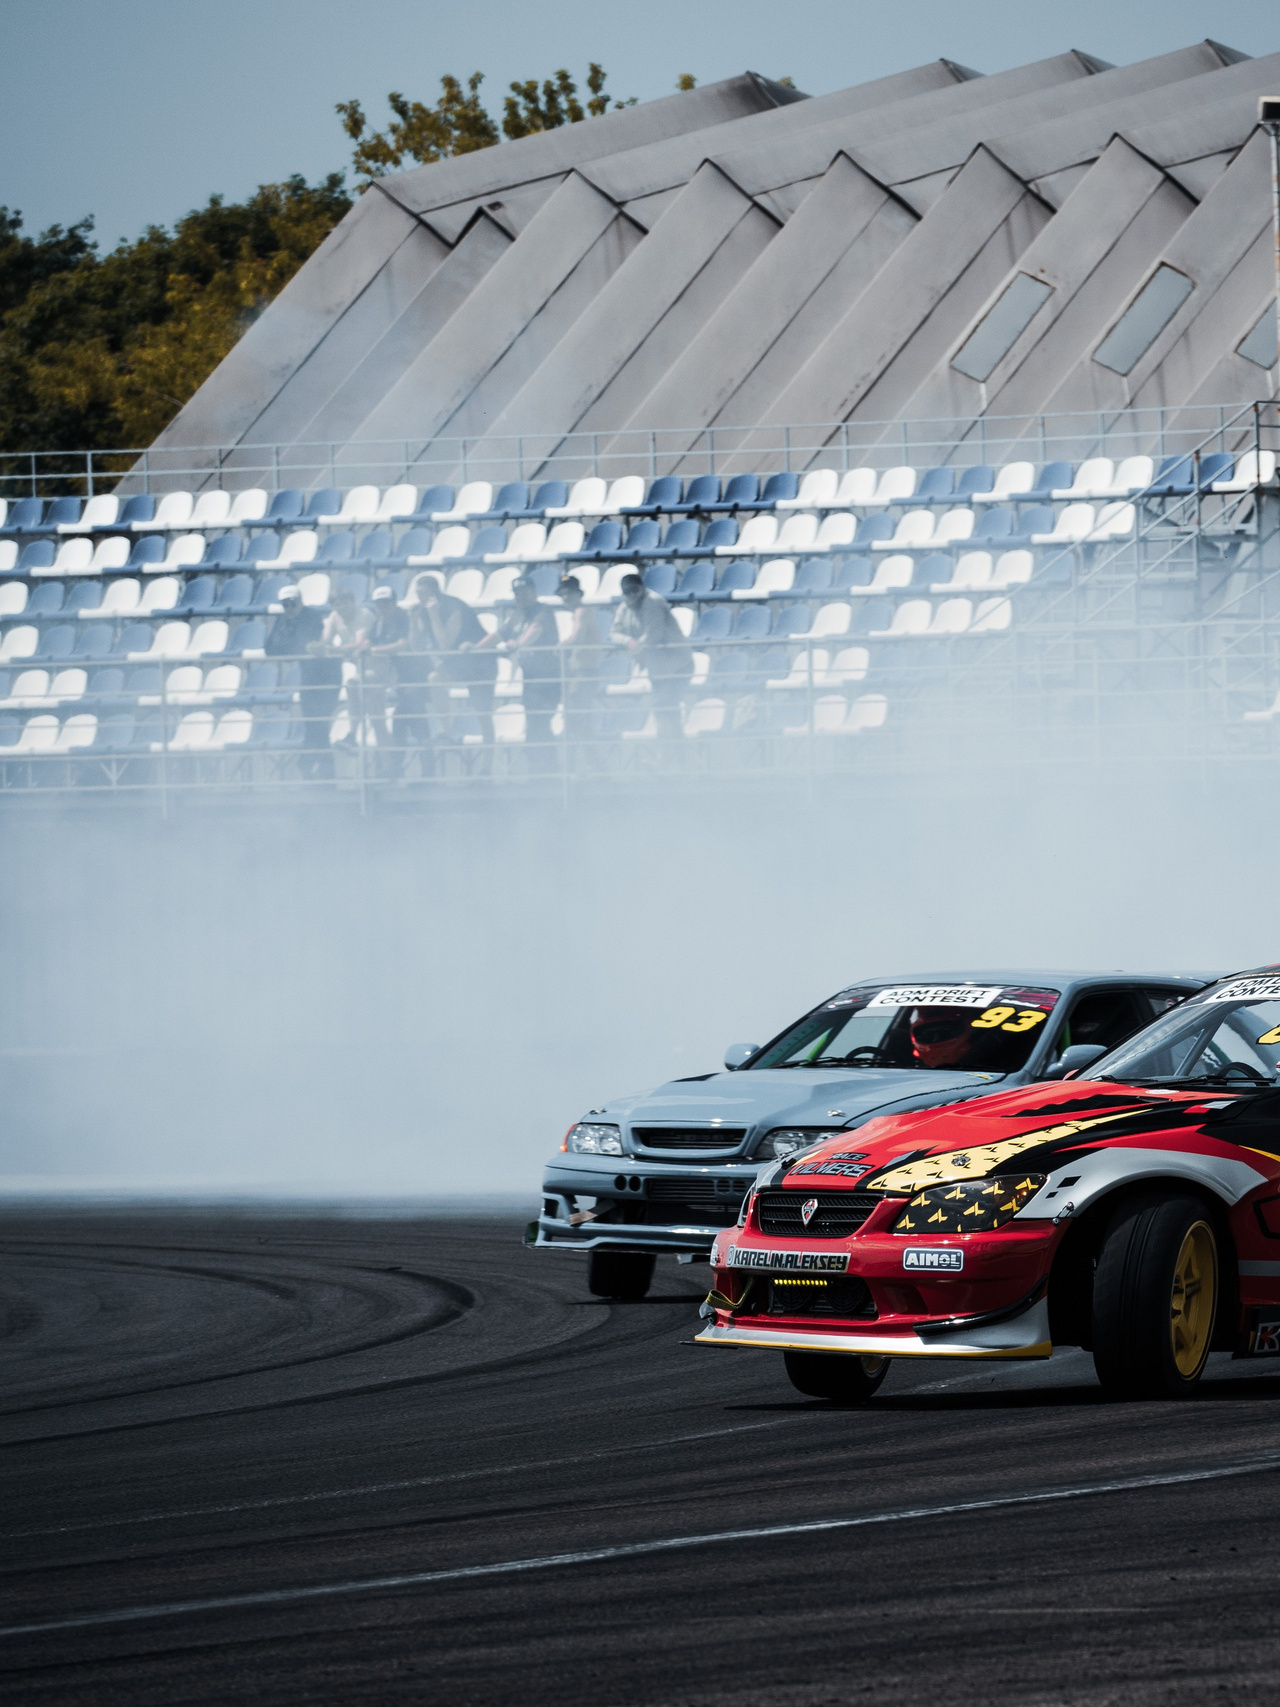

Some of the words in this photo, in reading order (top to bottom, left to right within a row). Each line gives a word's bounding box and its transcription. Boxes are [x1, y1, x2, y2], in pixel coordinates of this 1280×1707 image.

[1230, 977, 1273, 989] ADM
[887, 989, 932, 997] ADM
[933, 989, 992, 997] DRIFT
[879, 995, 984, 1005] CONTEST
[971, 1006, 1048, 1033] 93
[826, 1152, 870, 1161] RACE
[789, 1161, 874, 1178] VILMERS
[905, 1252, 960, 1267] AIMOL
